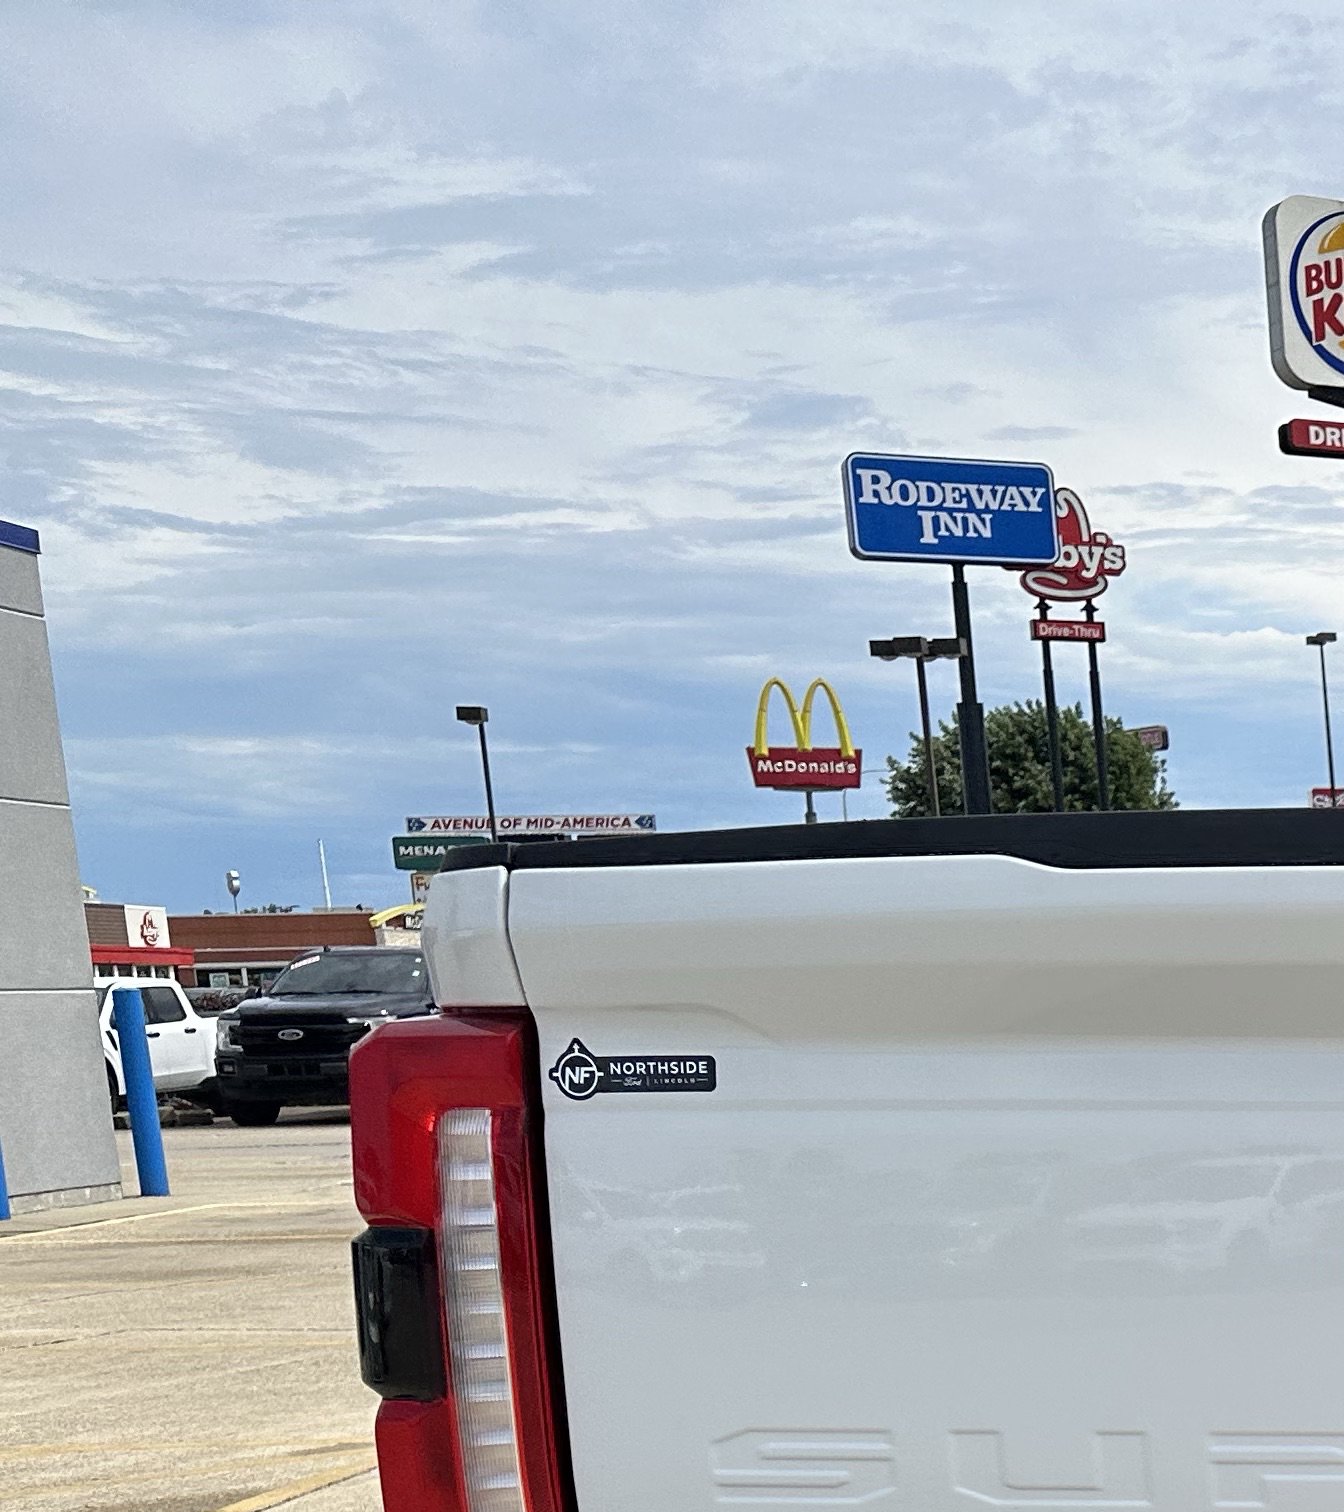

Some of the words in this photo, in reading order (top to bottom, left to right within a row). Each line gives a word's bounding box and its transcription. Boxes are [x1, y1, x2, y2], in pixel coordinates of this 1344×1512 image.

[856, 468, 1046, 512] RODEWAY
[917, 510, 993, 544] INN
[1054, 533, 1125, 578] by's
[1039, 623, 1100, 638] Drive-Thru
[757, 759, 857, 774] McDonald's
[431, 818, 493, 830] AVENUE
[500, 817, 522, 829] OF
[526, 816, 632, 829] MID-AMERICA
[609, 1061, 708, 1075] NORTHSIDE
[565, 1066, 596, 1090] NF
